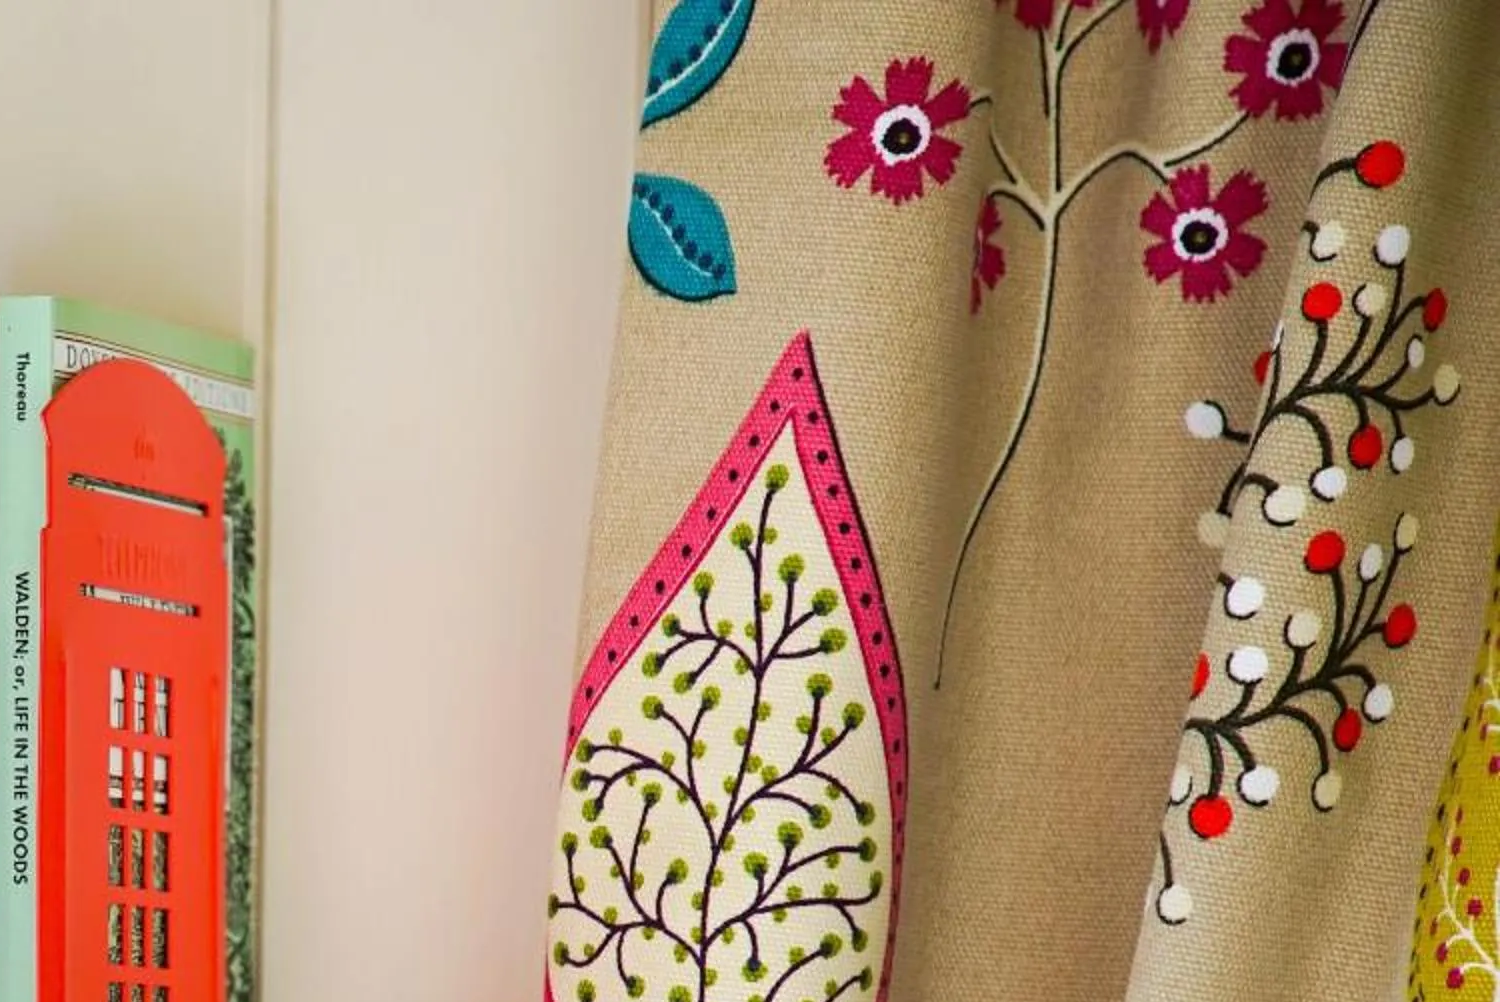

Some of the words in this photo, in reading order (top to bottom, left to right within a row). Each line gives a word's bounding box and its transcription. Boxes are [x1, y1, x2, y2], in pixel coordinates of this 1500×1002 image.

[16, 351, 31, 422] Thoreau
[12, 571, 31, 661] WALDEN;
[12, 665, 26, 692] or,
[13, 696, 30, 734] LIFE
[13, 737, 30, 759] IN
[13, 760, 30, 800] THE
[12, 804, 30, 887] WOODS
